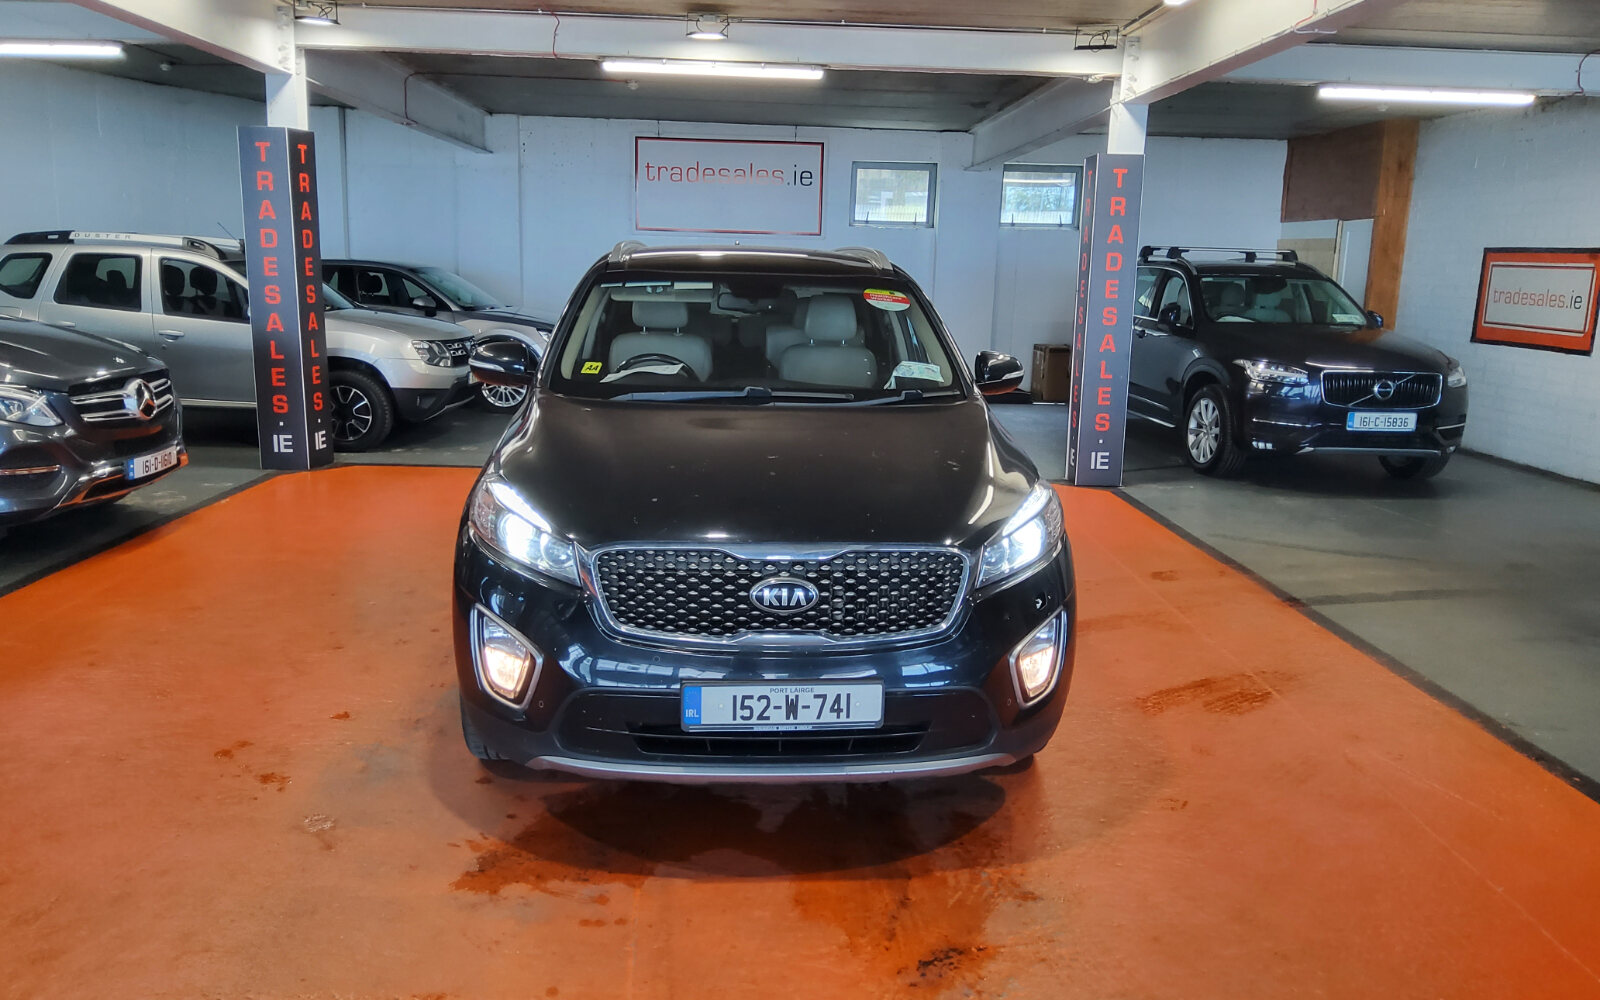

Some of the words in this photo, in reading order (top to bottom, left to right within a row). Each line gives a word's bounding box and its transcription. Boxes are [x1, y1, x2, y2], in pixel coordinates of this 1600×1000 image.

[645, 161, 813, 186] tradesales.ie
[1493, 288, 1583, 310] tradesales.ie
[763, 588, 807, 606] KIA
[685, 709, 699, 718] IRL
[732, 693, 851, 721] 152-W-741
